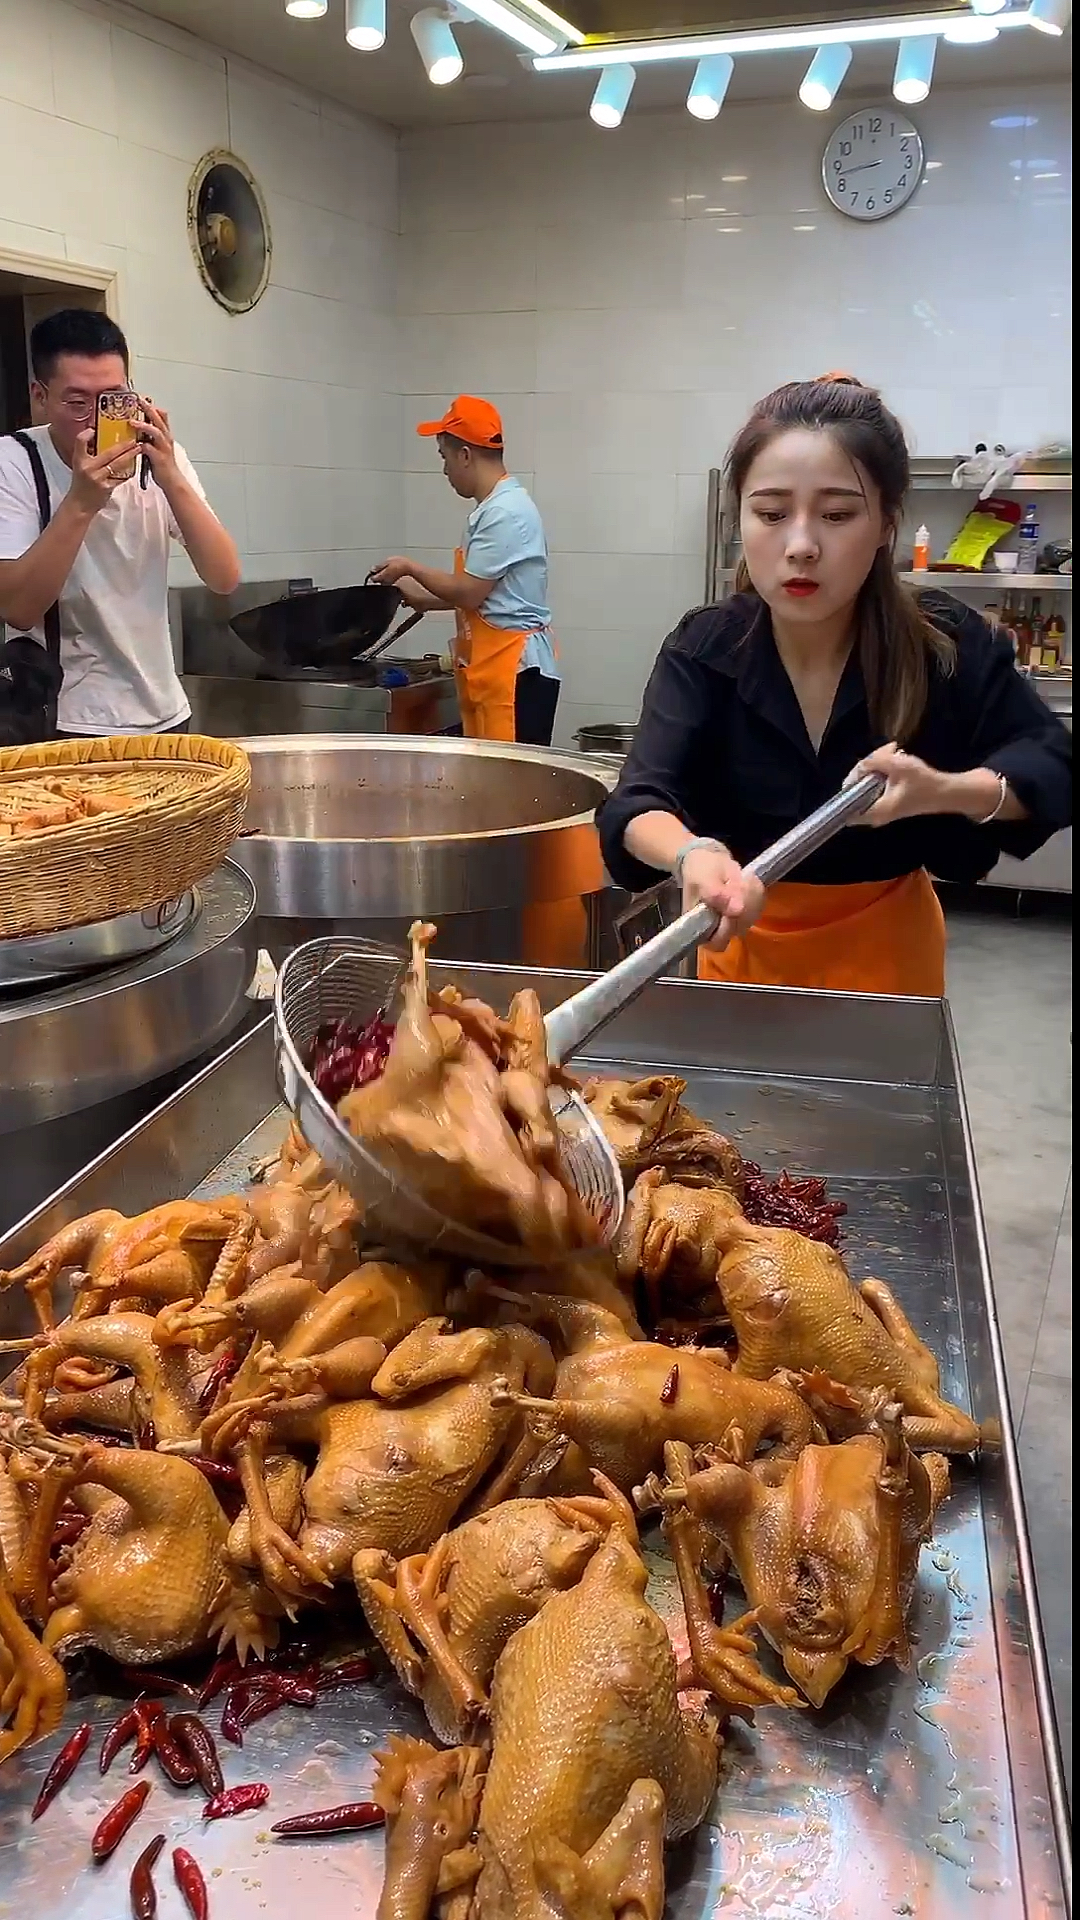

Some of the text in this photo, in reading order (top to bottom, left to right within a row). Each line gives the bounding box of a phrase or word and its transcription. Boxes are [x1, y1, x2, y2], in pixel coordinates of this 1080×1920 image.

[853, 125, 863, 139] 11
[869, 118, 882, 132] 12
[890, 123, 894, 137] 1
[839, 142, 851, 156] 10
[900, 137, 909, 152] 2
[834, 161, 842, 175] 9
[905, 155, 912, 169] 3
[838, 179, 846, 192] 8
[898, 175, 906, 186] 4
[851, 192, 858, 206] 7
[866, 196, 874, 210] 6
[884, 189, 892, 203] 5
